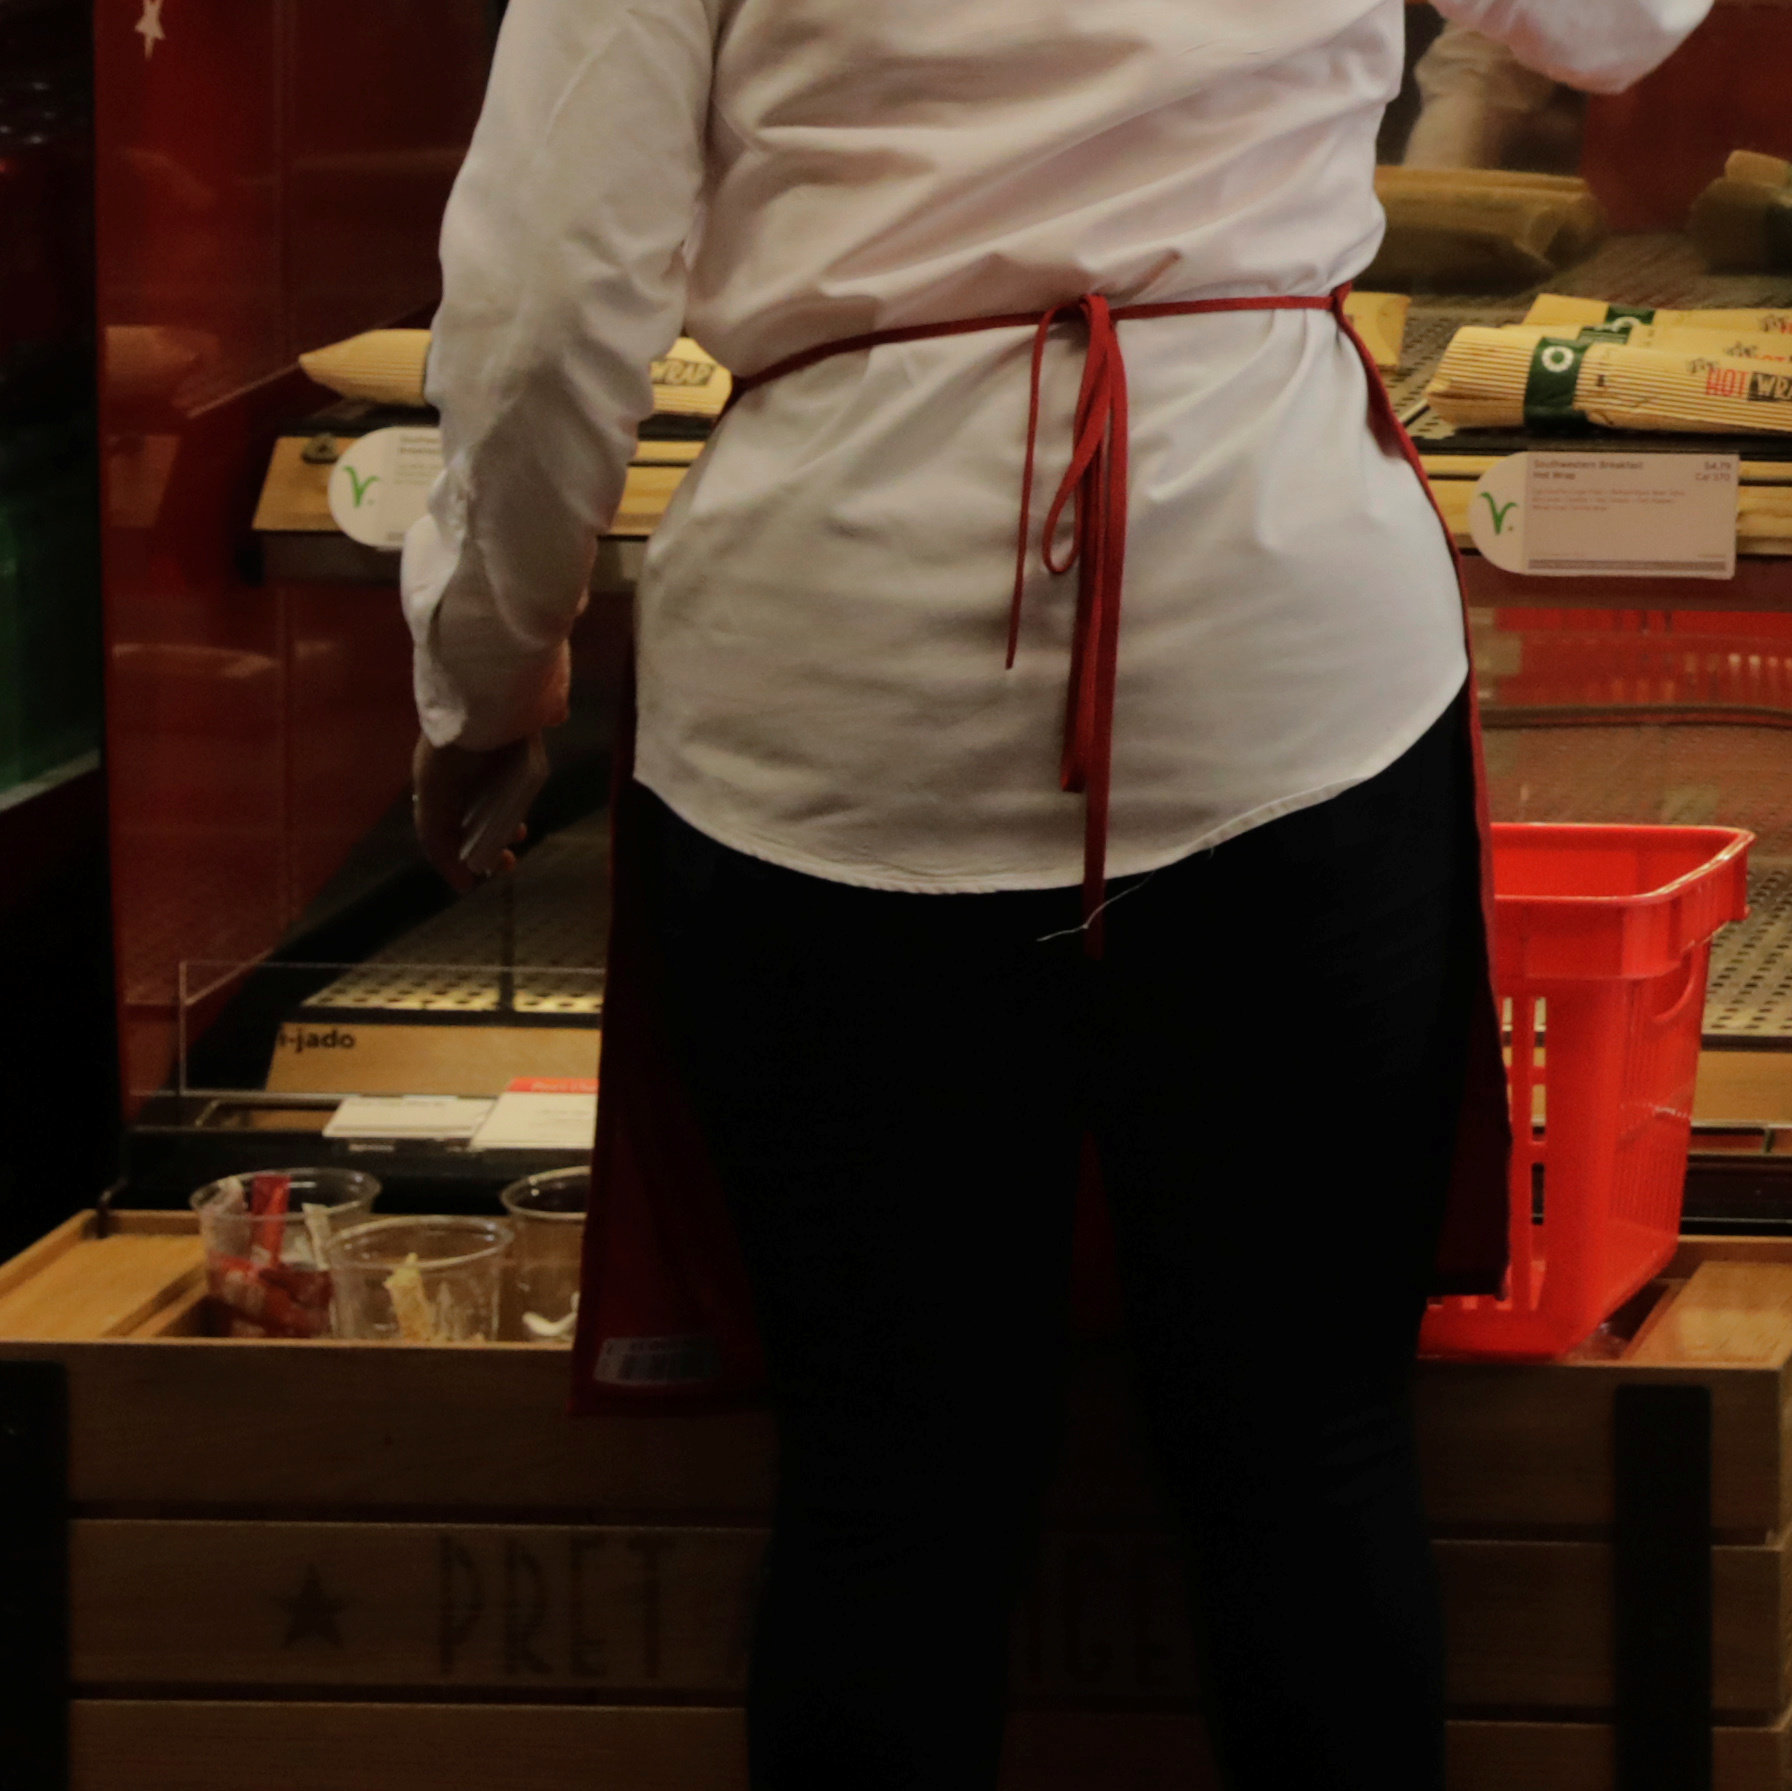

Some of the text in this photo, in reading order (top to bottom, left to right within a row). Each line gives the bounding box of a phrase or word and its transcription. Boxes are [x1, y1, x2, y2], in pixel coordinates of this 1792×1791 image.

[1706, 368, 1750, 398] HOT
[1533, 460, 1644, 470] Southwestern Breakfast
[440, 1533, 676, 1679] PRET
